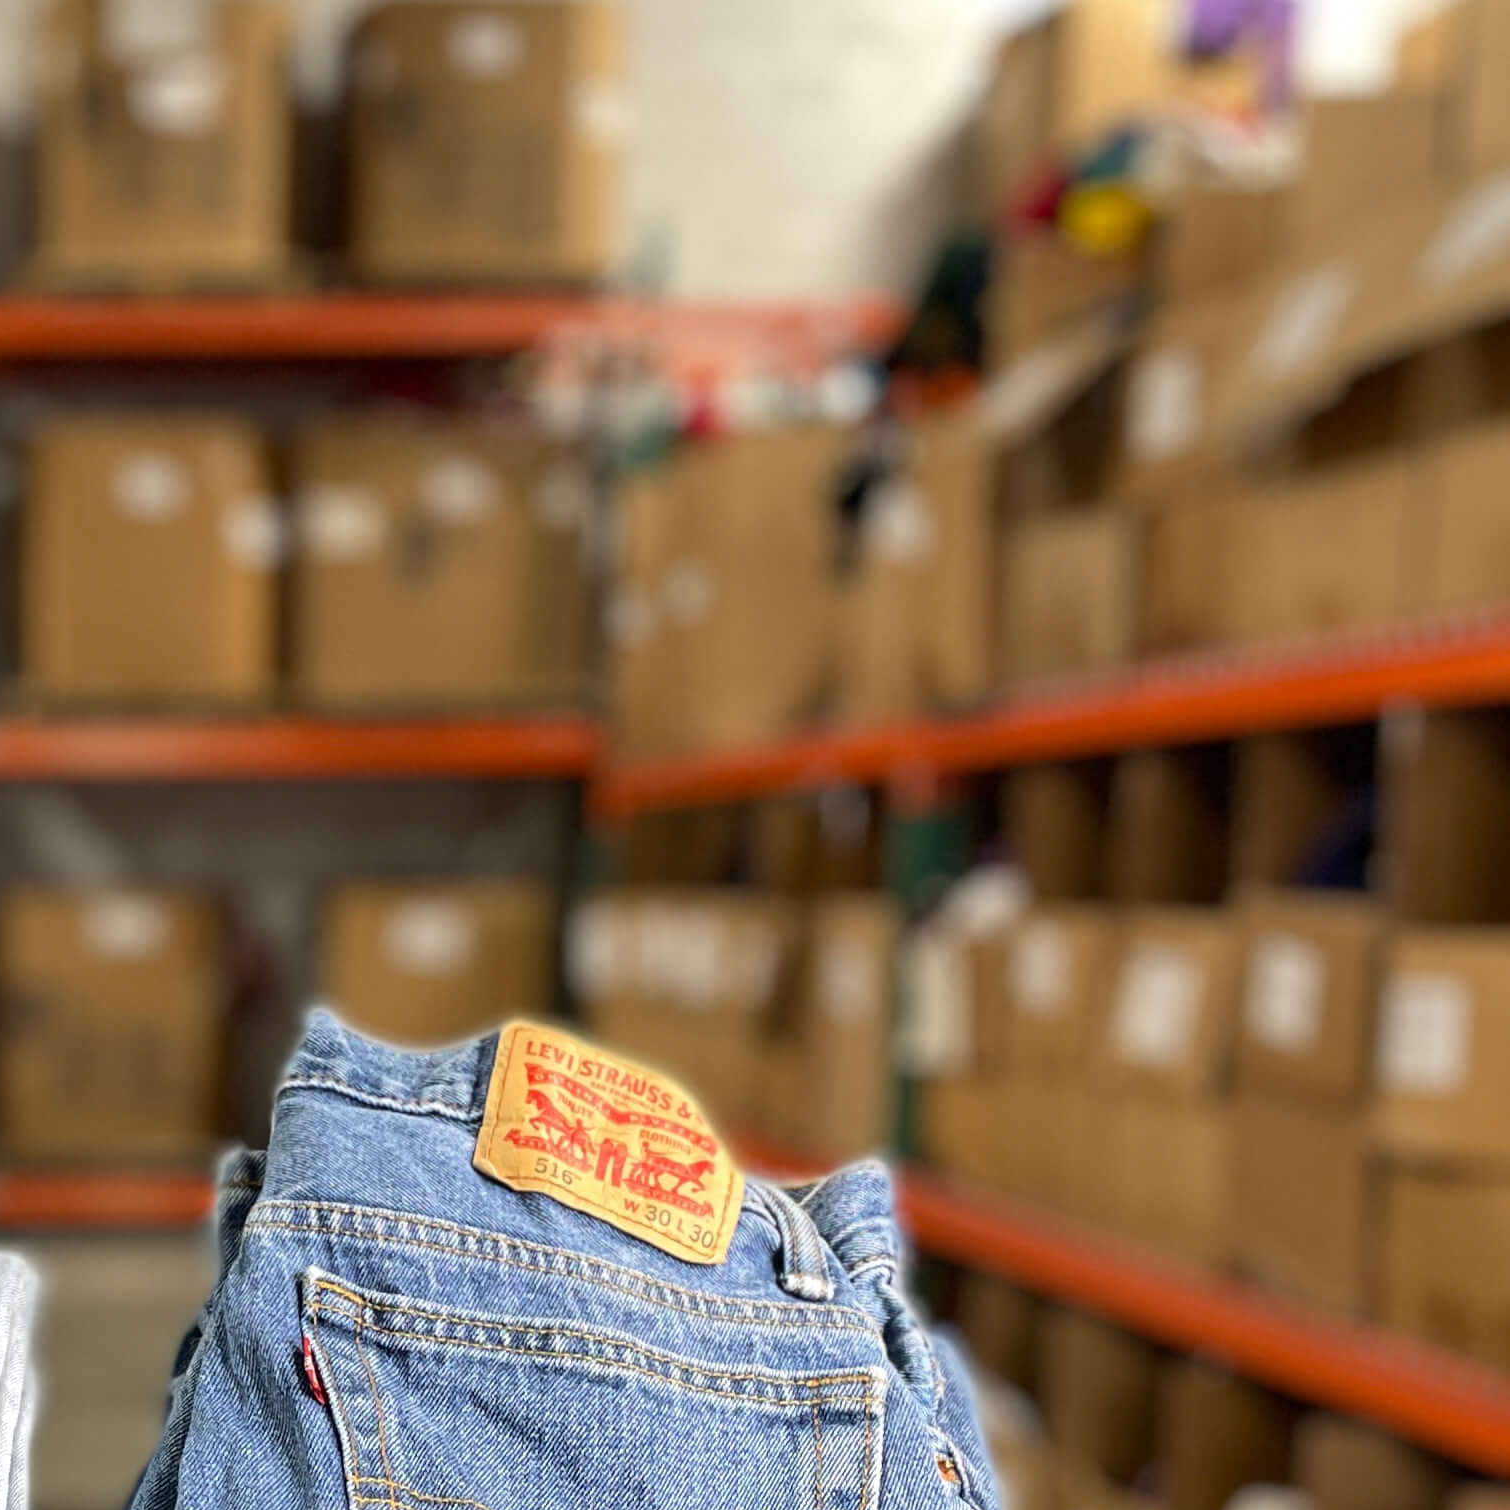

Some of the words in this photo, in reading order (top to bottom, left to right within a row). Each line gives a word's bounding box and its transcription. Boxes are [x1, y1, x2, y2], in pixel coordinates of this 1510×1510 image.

[526, 1041, 574, 1070] LEVI
[580, 1060, 673, 1111] STRAUSS
[677, 1102, 693, 1119] &
[557, 1092, 595, 1119] UALITY
[623, 1197, 640, 1214] W
[644, 1203, 672, 1226] 30
[675, 1217, 685, 1234] L
[688, 1223, 715, 1249] 30
